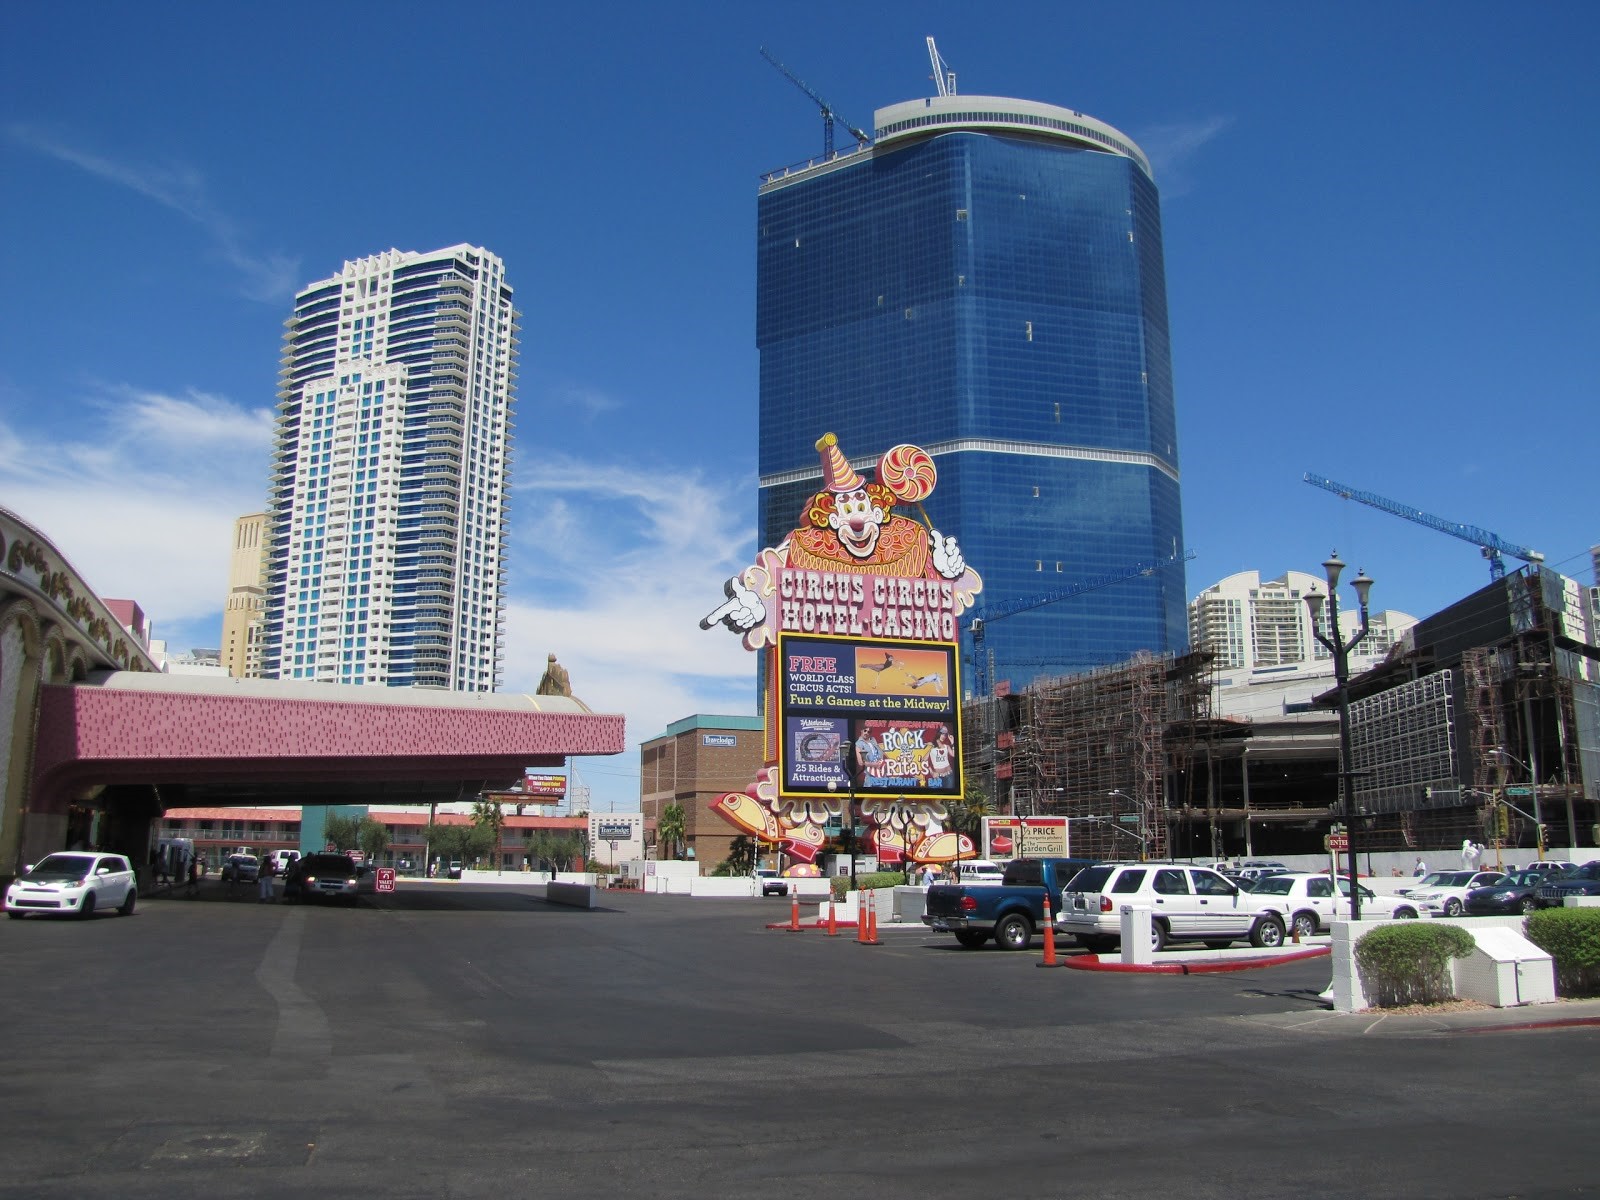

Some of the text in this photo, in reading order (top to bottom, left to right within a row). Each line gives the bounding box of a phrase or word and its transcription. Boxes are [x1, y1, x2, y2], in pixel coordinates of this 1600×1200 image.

[780, 570, 953, 609] CIRCUS CIRCUS
[781, 601, 954, 640] HOTEL CASINO
[789, 656, 837, 673] FREE
[790, 673, 855, 684] WORLD CLASS
[789, 684, 852, 693] CIRCUS ACTS!
[789, 694, 950, 712] Fun & Games at the Midway!
[864, 719, 944, 729] GREAT AMERICAN PARTY
[705, 736, 735, 745] Travelodge
[881, 729, 926, 751] ROCK
[795, 764, 840, 773] 25 Rides &
[884, 756, 930, 776] Rita's
[869, 777, 943, 787] RESTAURANT BAR
[1032, 827, 1056, 835] PRICE
[1022, 844, 1064, 852] Garden Grill
